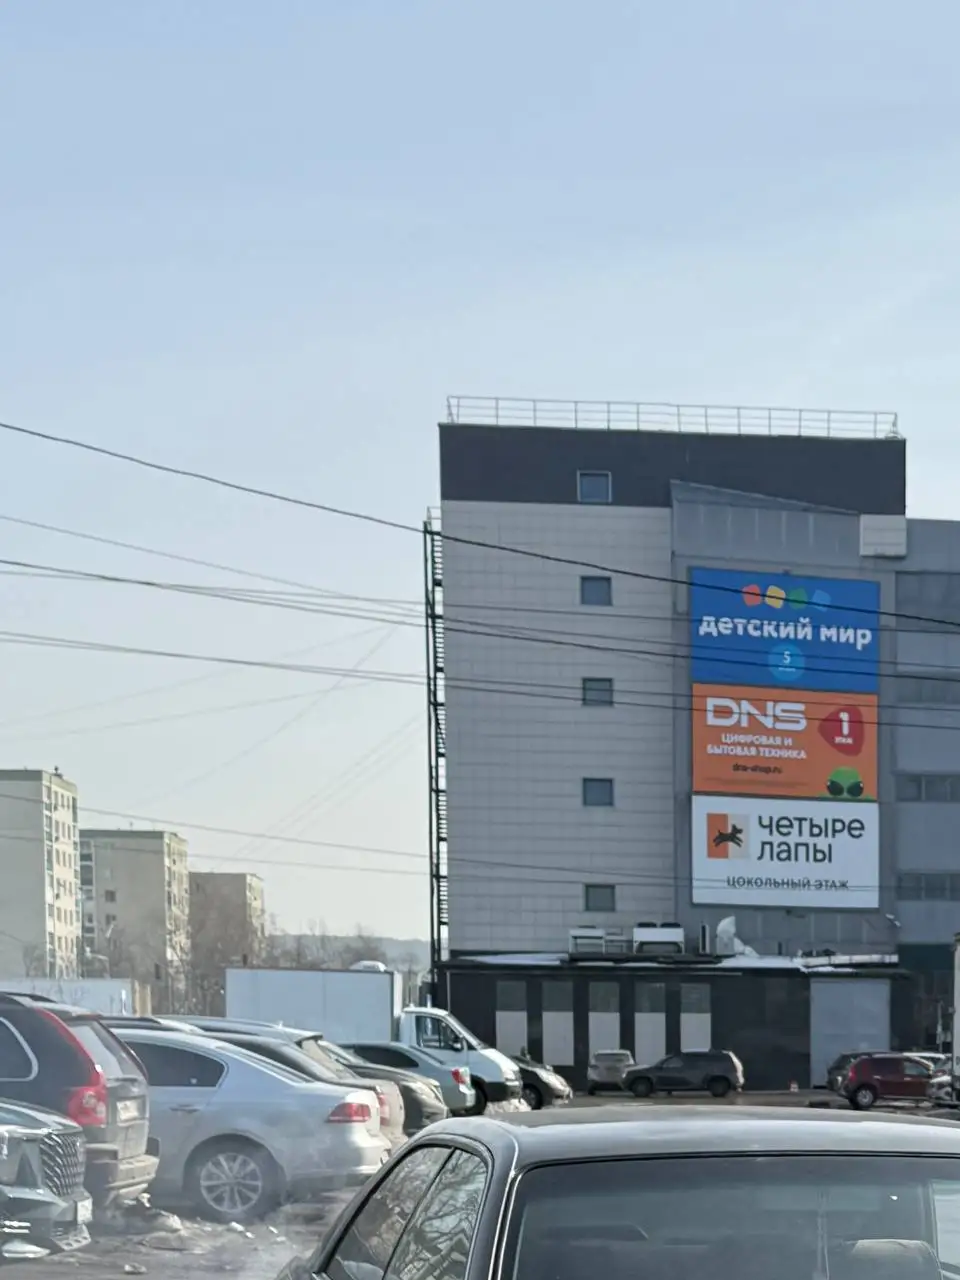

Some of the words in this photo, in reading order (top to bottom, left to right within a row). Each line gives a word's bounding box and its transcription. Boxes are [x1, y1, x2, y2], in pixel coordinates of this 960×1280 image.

[698, 615, 813, 642] детский
[819, 625, 873, 651] мир
[782, 650, 792, 664] 5
[705, 697, 808, 732] DNS
[838, 711, 851, 737] 1
[721, 732, 782, 746] ЦИФРОВАЯ
[784, 736, 794, 746] И
[706, 743, 758, 757] БЫТОВАЯ
[759, 747, 808, 760] ТЕХНИКА
[757, 814, 866, 840] четыре
[756, 840, 833, 864] лапы
[725, 873, 811, 891] ЦОКОЛЬНЫЙ
[814, 878, 849, 891] ЭТАЖ
